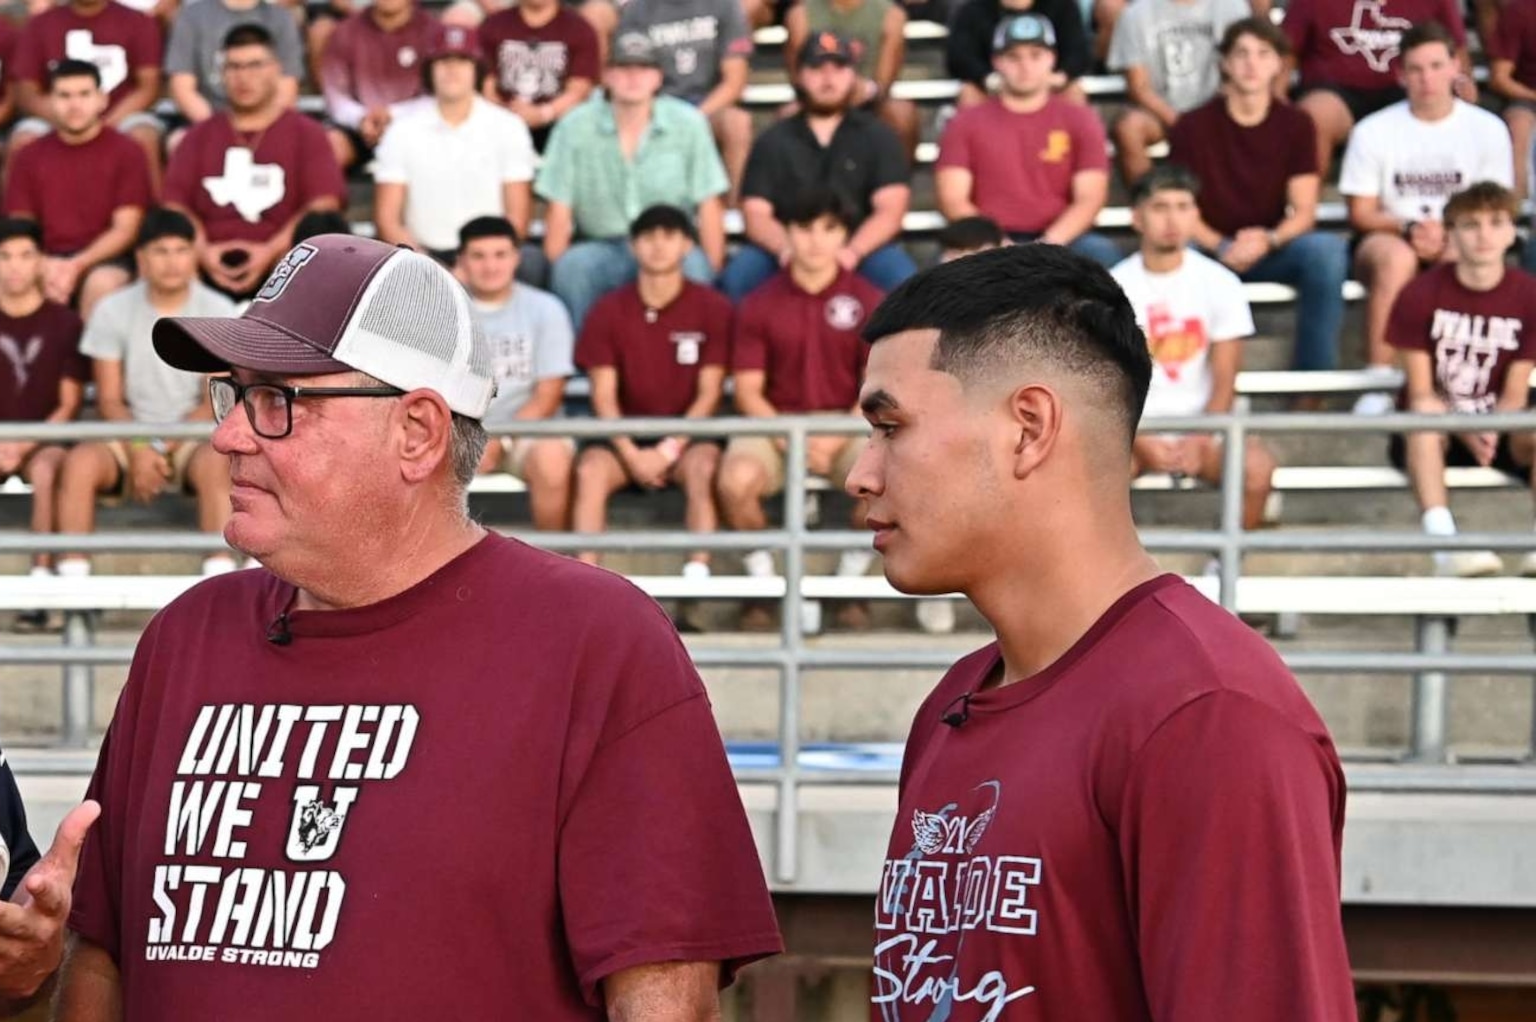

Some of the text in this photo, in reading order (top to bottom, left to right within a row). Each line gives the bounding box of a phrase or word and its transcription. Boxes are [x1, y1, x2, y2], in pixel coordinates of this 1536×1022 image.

[177, 704, 421, 780] UNITED
[163, 780, 264, 859] WE
[942, 815, 967, 855] 21
[147, 864, 347, 950] STAND
[145, 945, 320, 969] UVALDE STRONG
